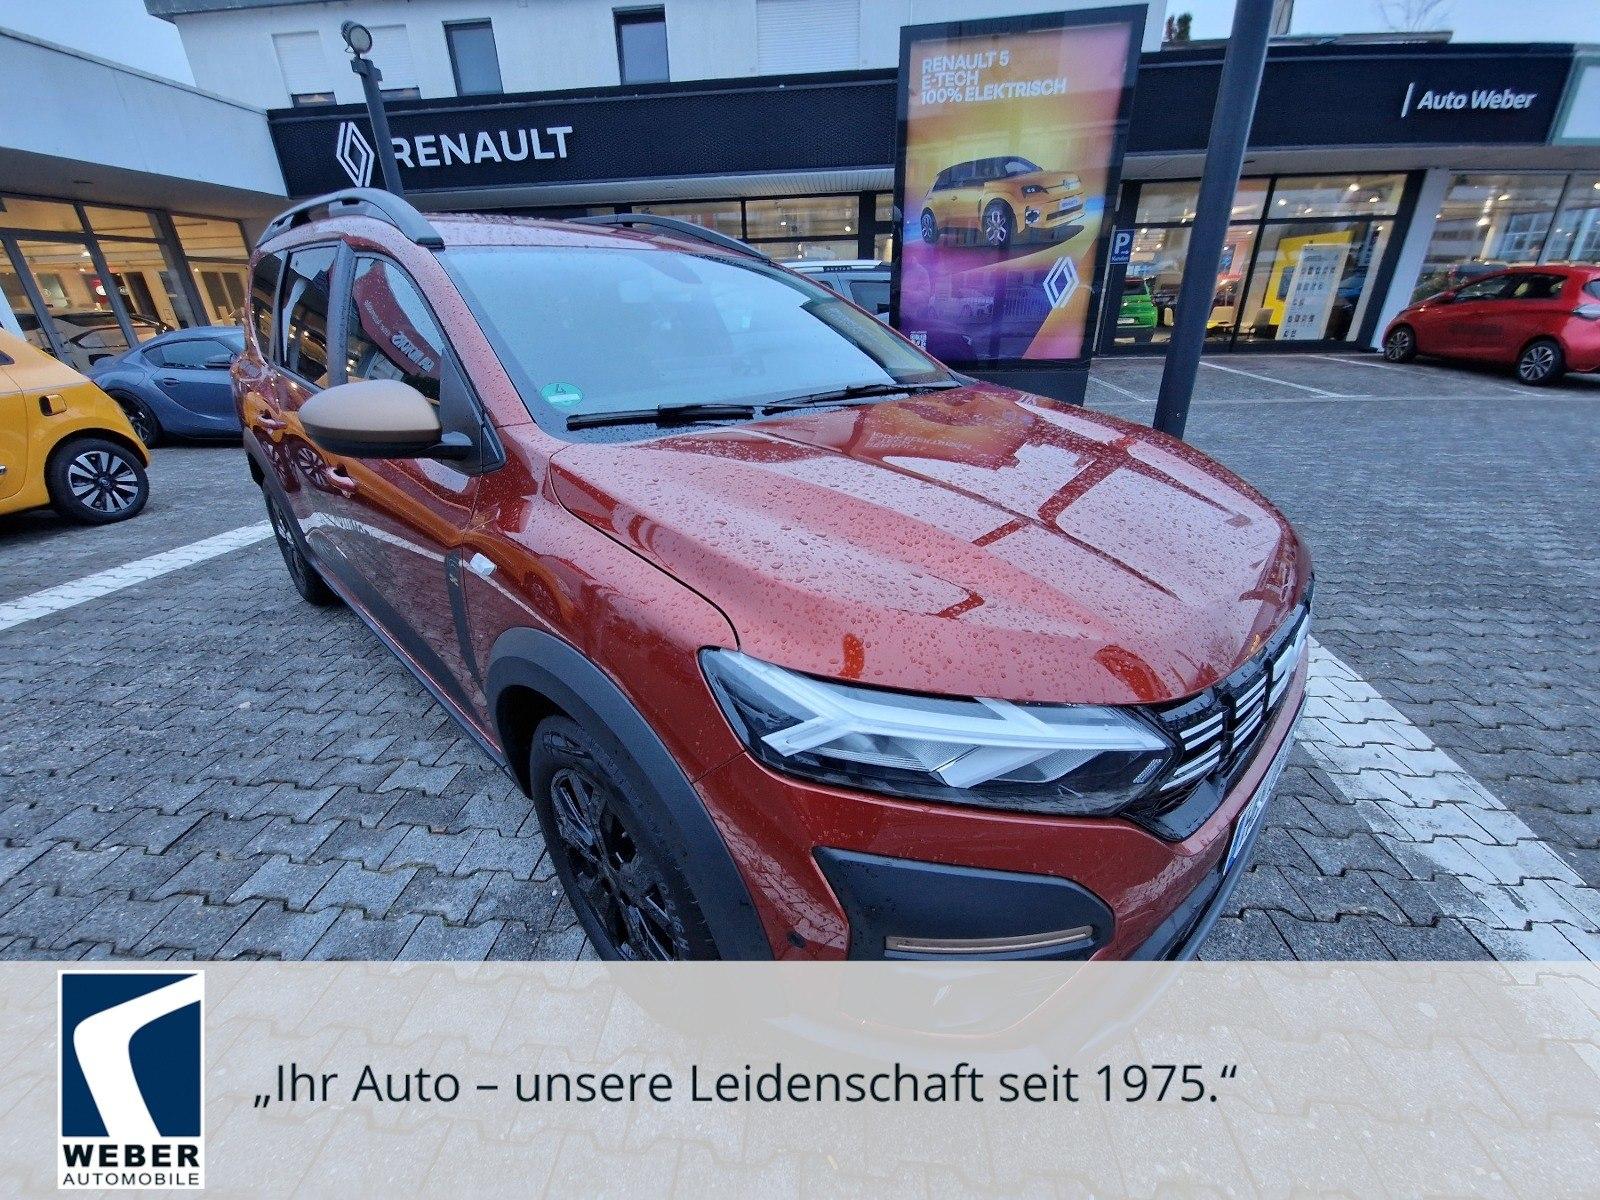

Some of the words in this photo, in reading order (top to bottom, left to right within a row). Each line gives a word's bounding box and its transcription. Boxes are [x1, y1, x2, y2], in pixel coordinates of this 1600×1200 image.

[922, 50, 997, 74] RENAULT
[920, 87, 964, 105] 100%
[964, 78, 1067, 102] ELEKTRISCH
[921, 70, 979, 91] E-TECH
[1417, 91, 1469, 111] Auto
[1470, 88, 1538, 110] Weber
[391, 126, 573, 168] RENAULT
[1114, 232, 1131, 255] P
